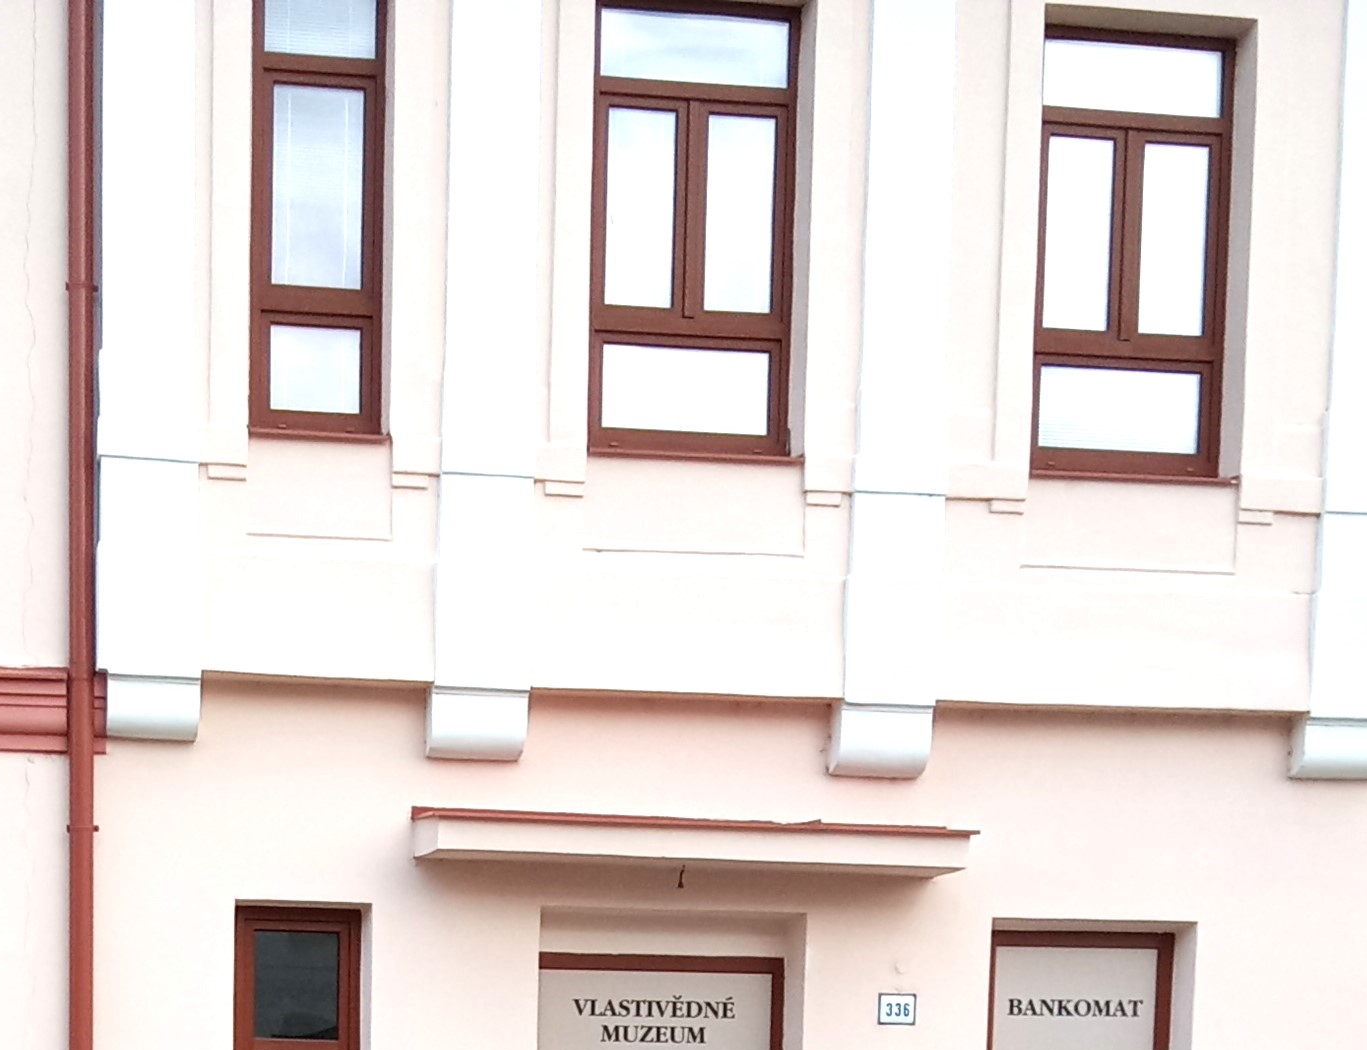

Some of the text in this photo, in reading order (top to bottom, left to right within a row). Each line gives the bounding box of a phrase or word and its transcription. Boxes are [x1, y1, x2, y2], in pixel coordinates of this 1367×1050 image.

[572, 995, 735, 1019] VLASTIVĚDNÉ
[886, 1003, 910, 1017] 336
[1007, 998, 1143, 1018] BANKOMAT
[600, 1025, 706, 1044] MUZEUM
